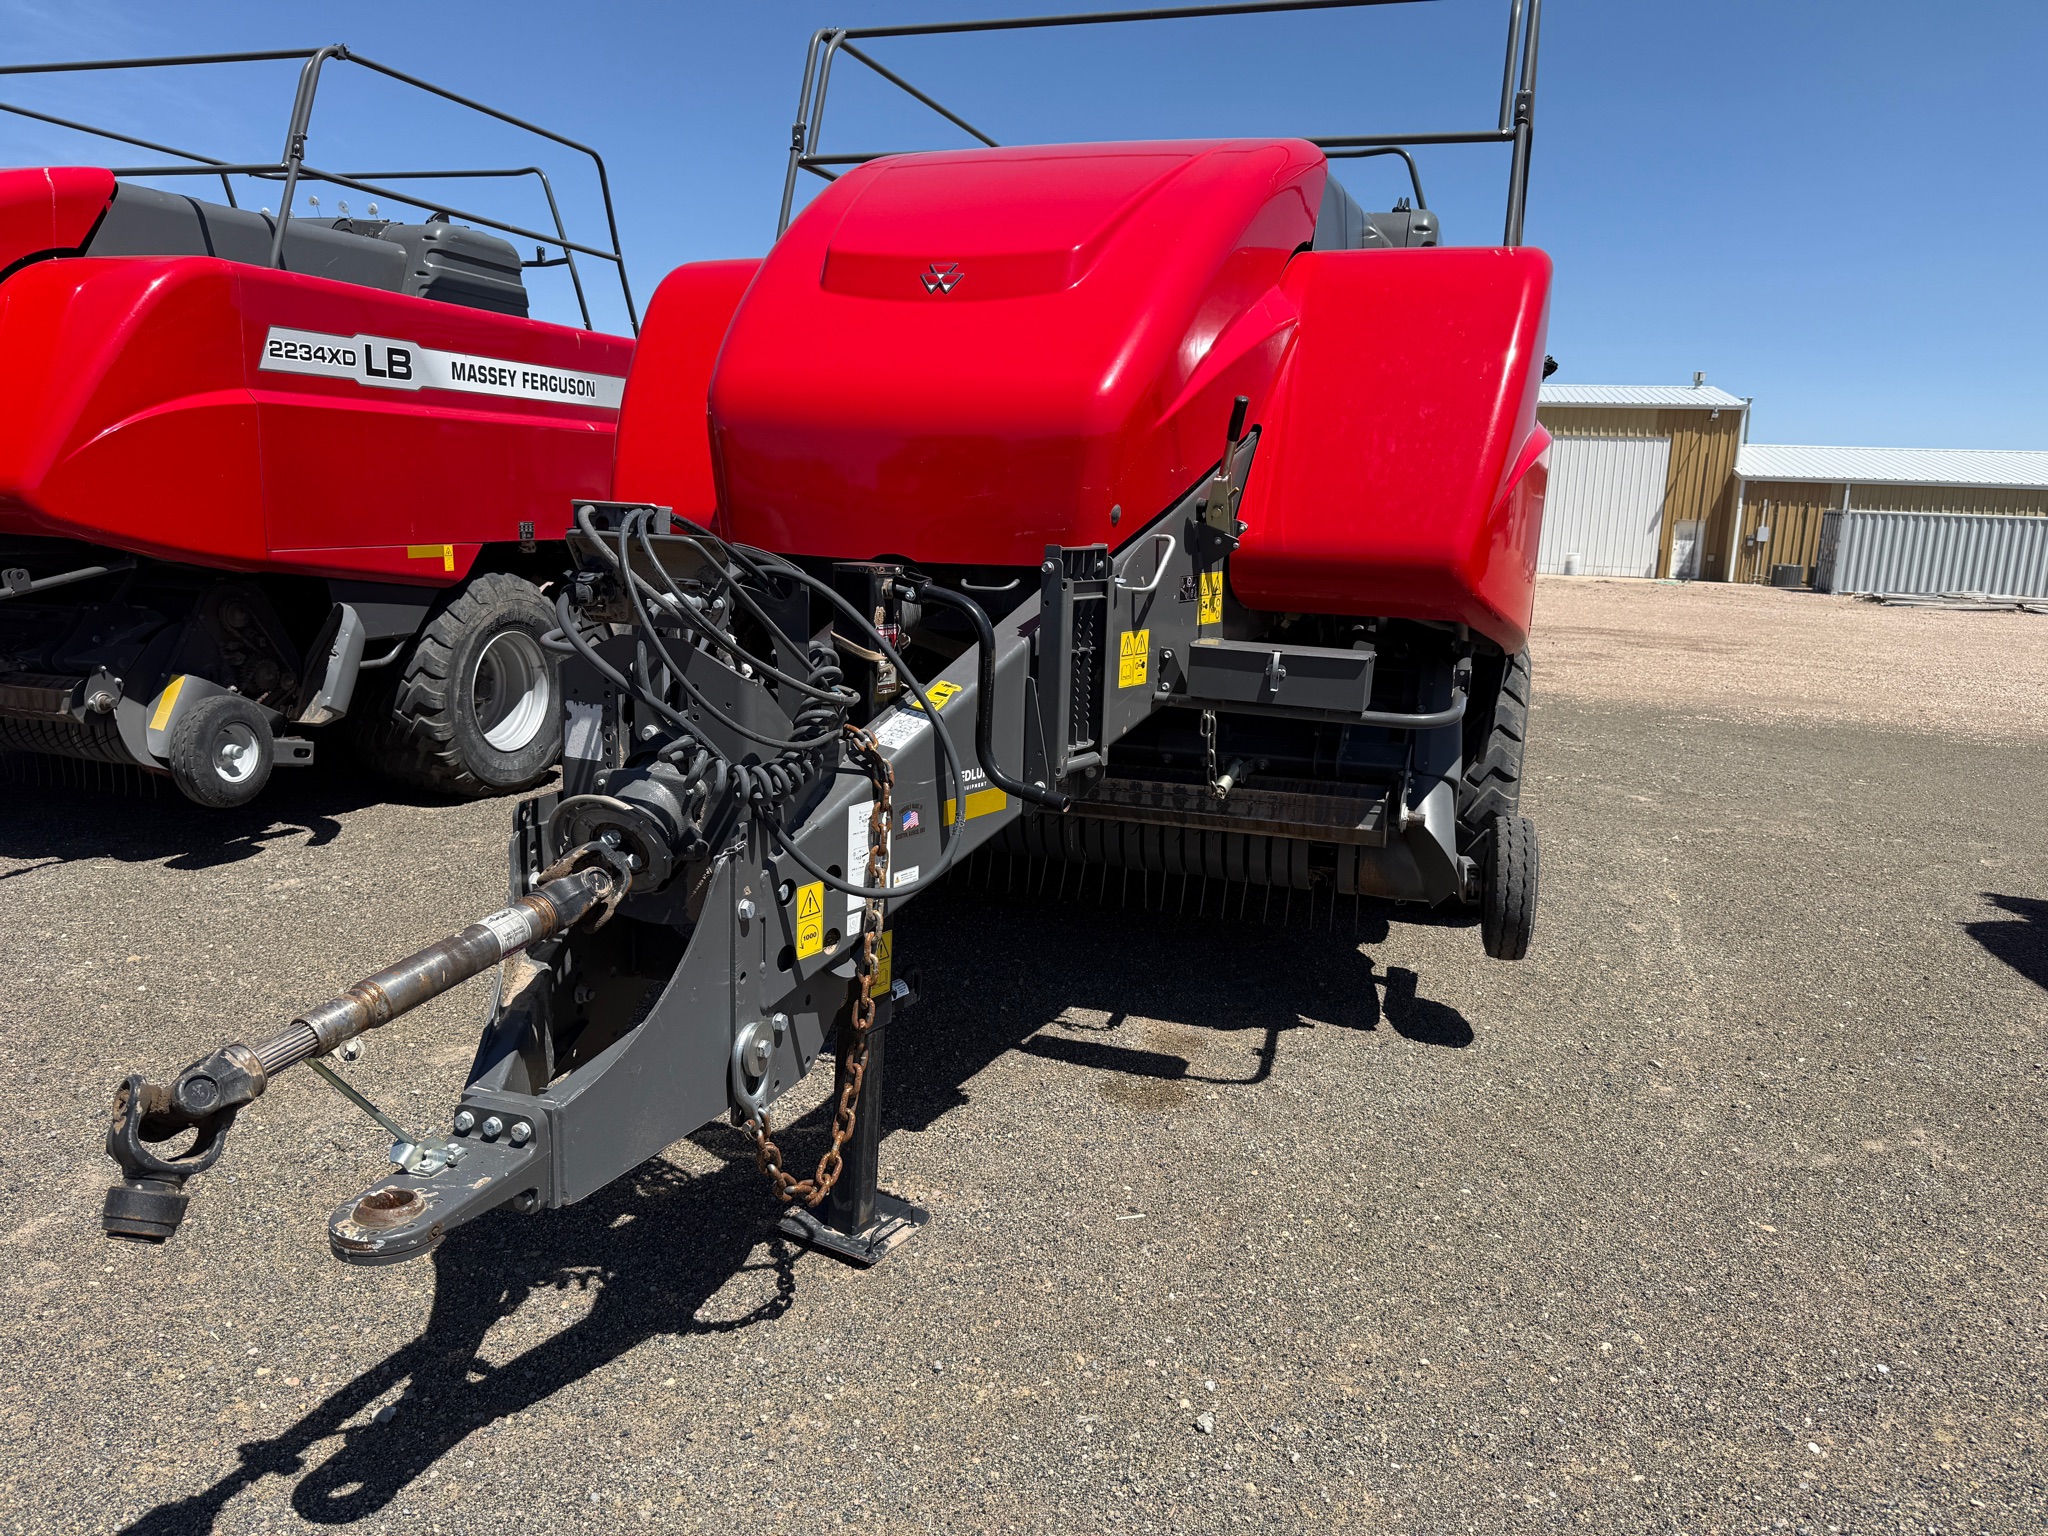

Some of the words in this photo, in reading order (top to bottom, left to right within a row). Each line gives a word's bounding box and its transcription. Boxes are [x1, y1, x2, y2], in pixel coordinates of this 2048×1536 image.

[268, 339, 357, 367] 2234XD
[364, 343, 412, 381] LB
[451, 361, 517, 388] MASSEY
[522, 371, 596, 398] FERGUSON
[803, 932, 817, 941] 1000
